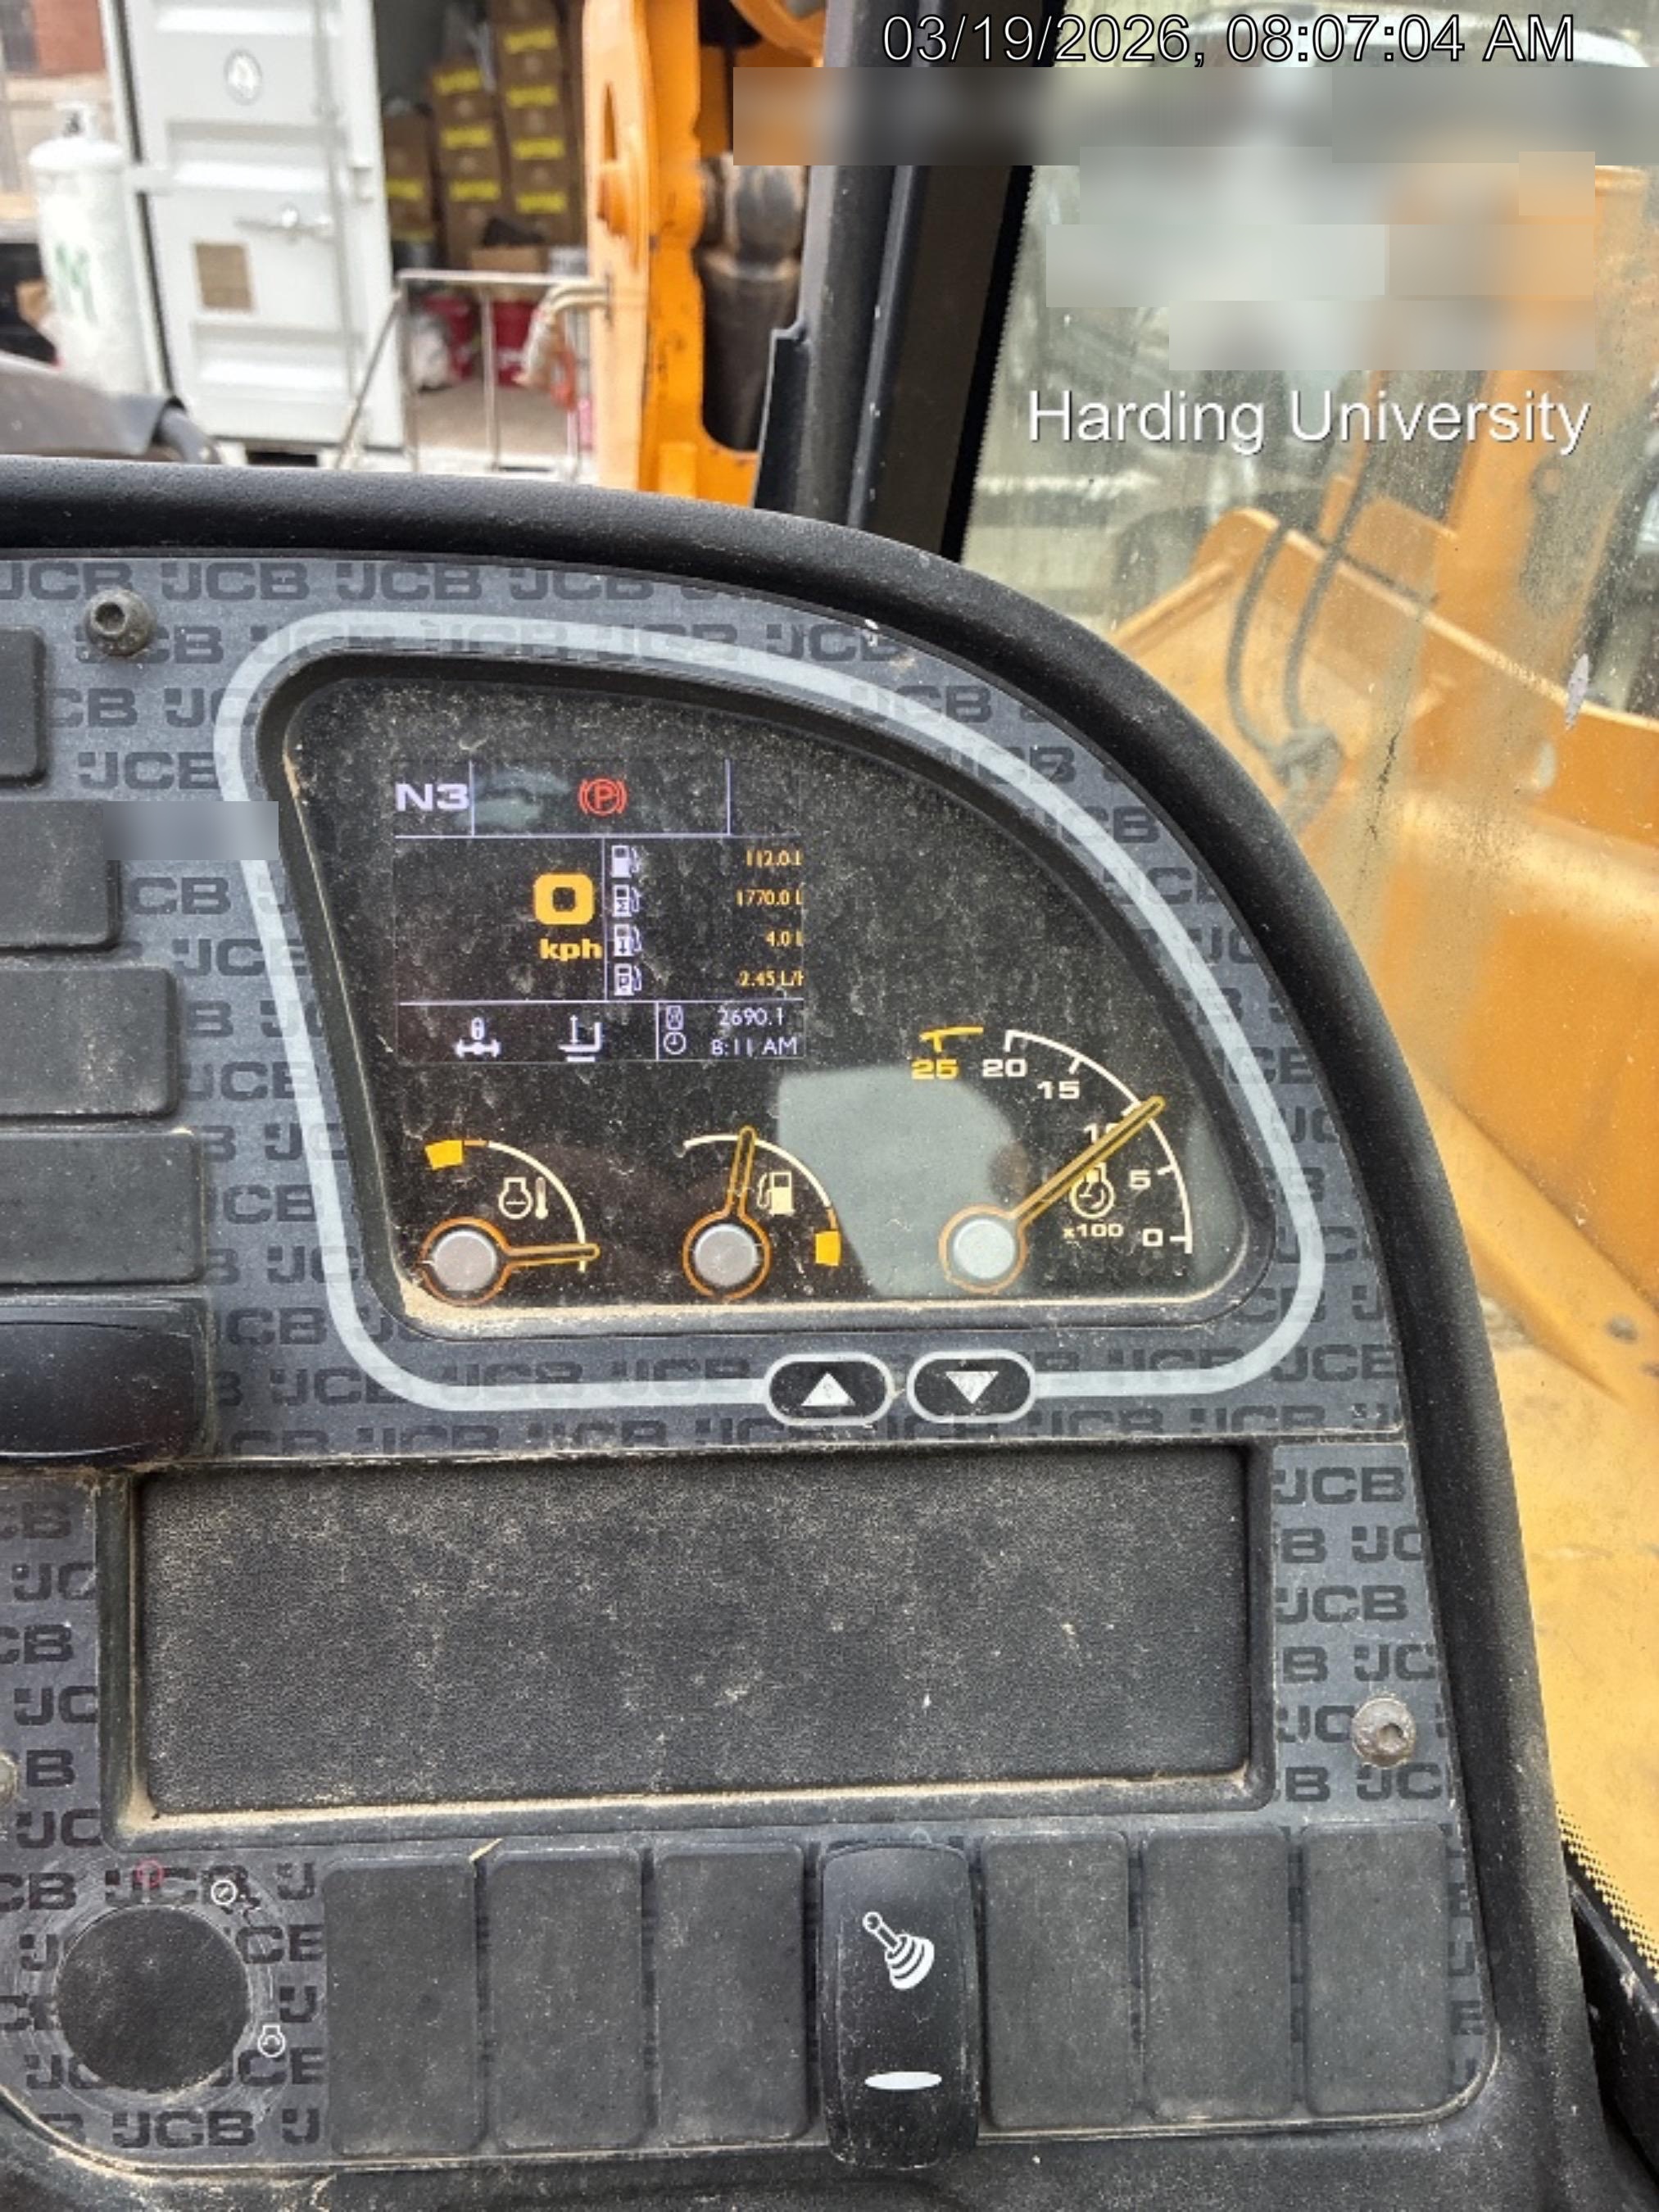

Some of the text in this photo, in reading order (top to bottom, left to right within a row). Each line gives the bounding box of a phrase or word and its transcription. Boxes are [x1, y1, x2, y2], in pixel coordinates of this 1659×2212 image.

[161, 562, 310, 600] JCB
[335, 561, 482, 600] JCB
[49, 687, 138, 728] CB
[395, 782, 469, 812] N3
[129, 877, 232, 915] CB
[533, 873, 596, 926] 0
[539, 937, 603, 962] kph
[760, 1036, 798, 1056] AM
[911, 1058, 1028, 1081] 25 20
[1037, 1081, 1081, 1099] 15
[1128, 1169, 1152, 1190] 5
[222, 1184, 318, 1224] CB
[1063, 1223, 1164, 1248] x100 0
[225, 1308, 327, 1345] CB
[1272, 1466, 1407, 1505] JCB
[1275, 1584, 1409, 1624] JCB
[235, 1925, 324, 1965] CB
[236, 2047, 324, 2087] CB
[112, 2110, 256, 2149] JCB
